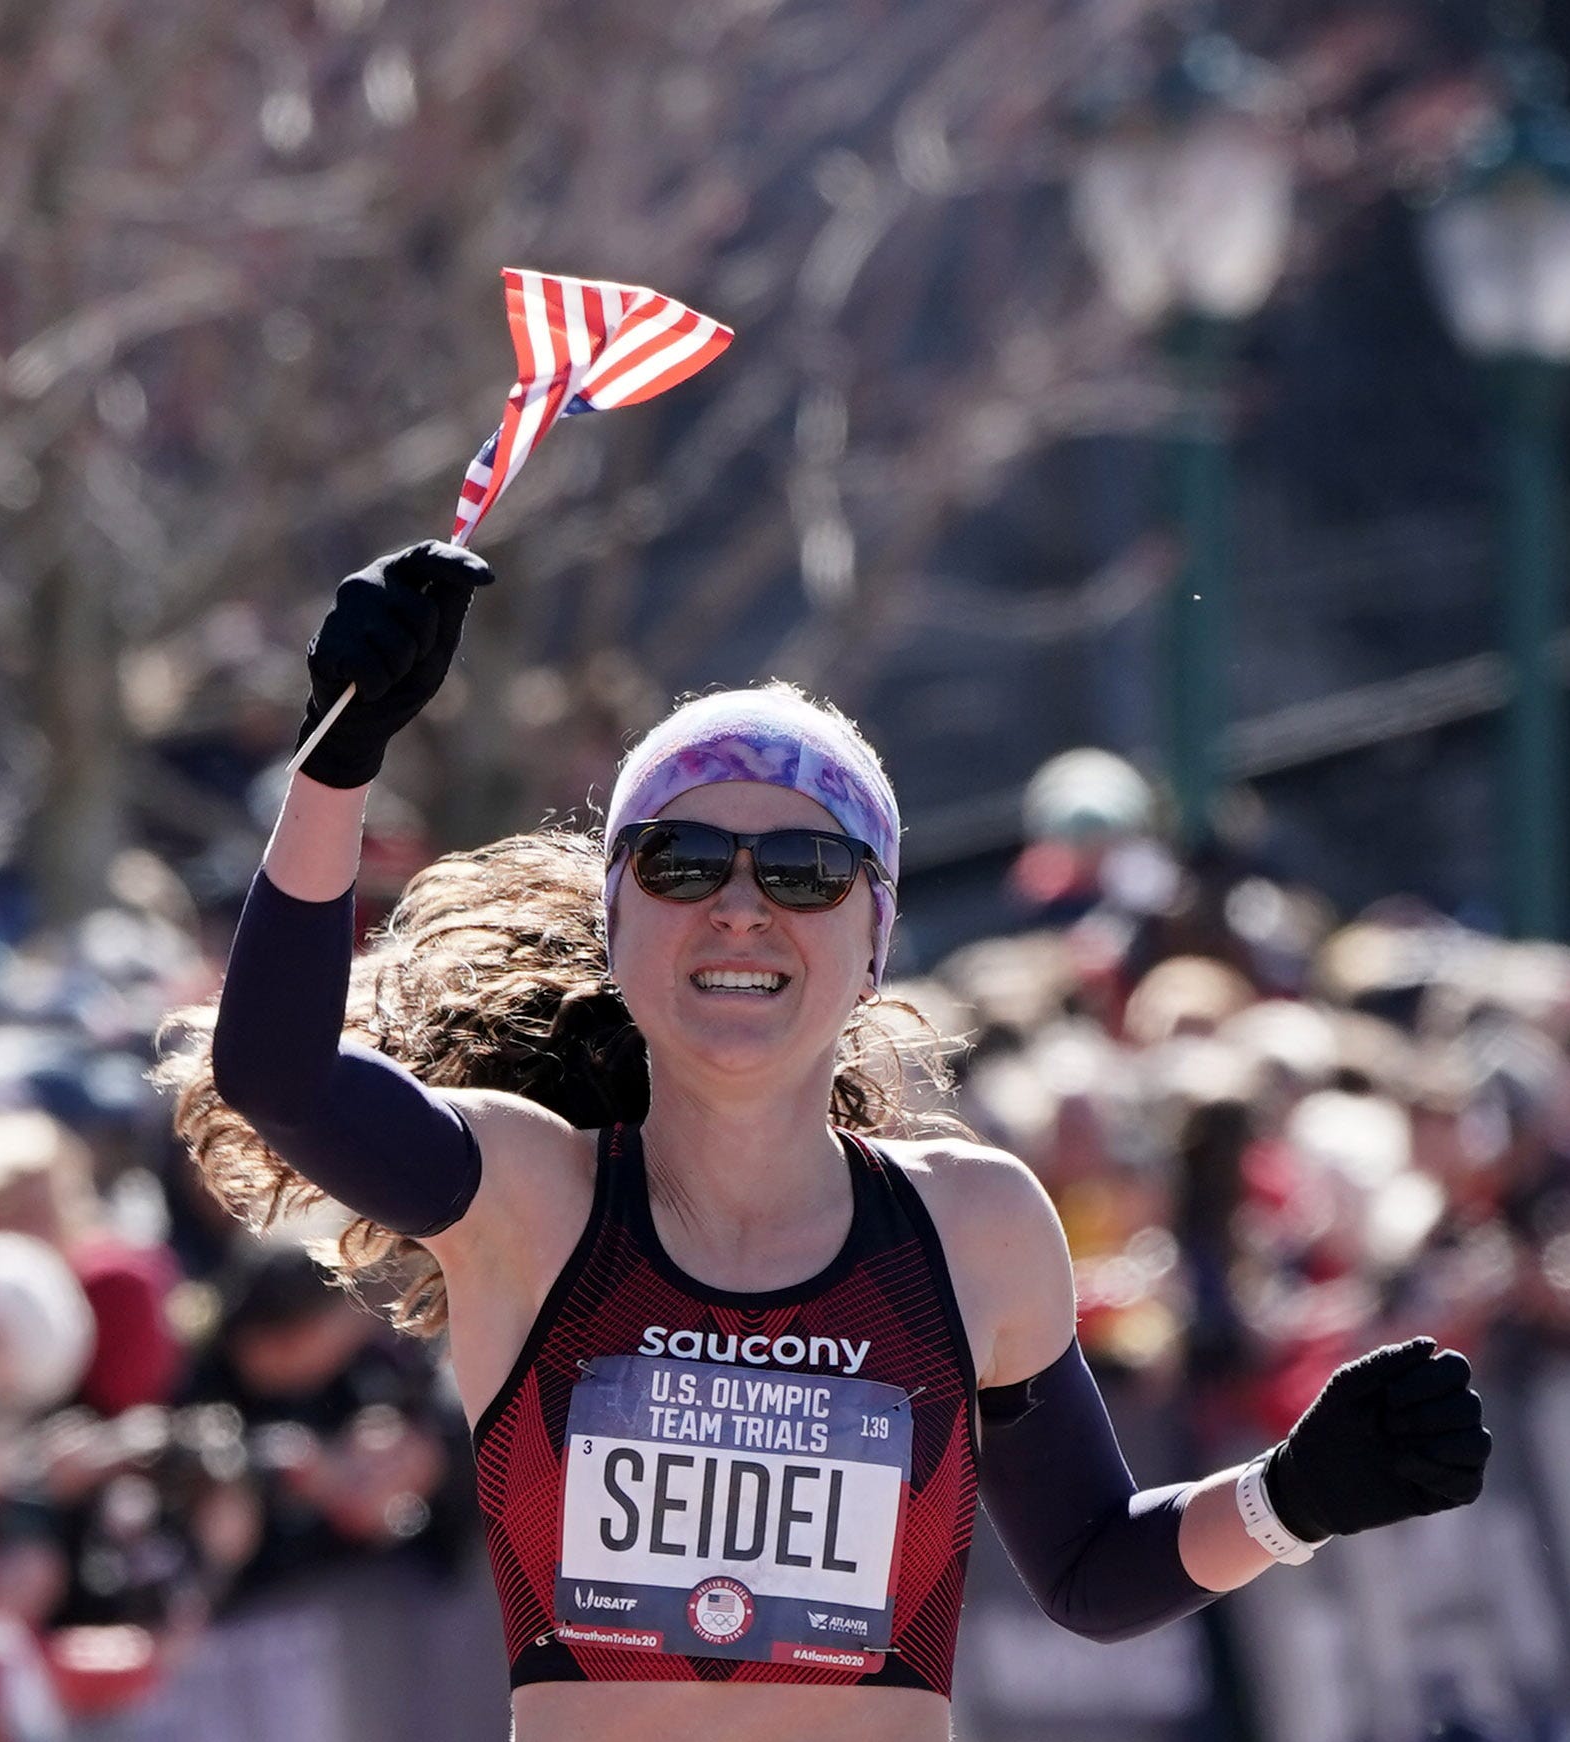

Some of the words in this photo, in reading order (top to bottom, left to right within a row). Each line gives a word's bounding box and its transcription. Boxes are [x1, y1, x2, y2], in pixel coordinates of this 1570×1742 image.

[638, 1326, 871, 1374] saucony
[651, 1371, 703, 1406] U.S.
[711, 1377, 830, 1419] OLYMPIC
[649, 1406, 722, 1443] TEAM
[732, 1415, 828, 1453] TRIALS
[860, 1415, 889, 1439] 139
[583, 1439, 593, 1455] 3
[600, 1447, 857, 1573] SEIDEL
[593, 1595, 638, 1611] USATF
[828, 1616, 868, 1631] ATLANTA
[558, 1628, 657, 1647] #MarathonTrials20
[793, 1649, 865, 1667] #Atlanta2020
